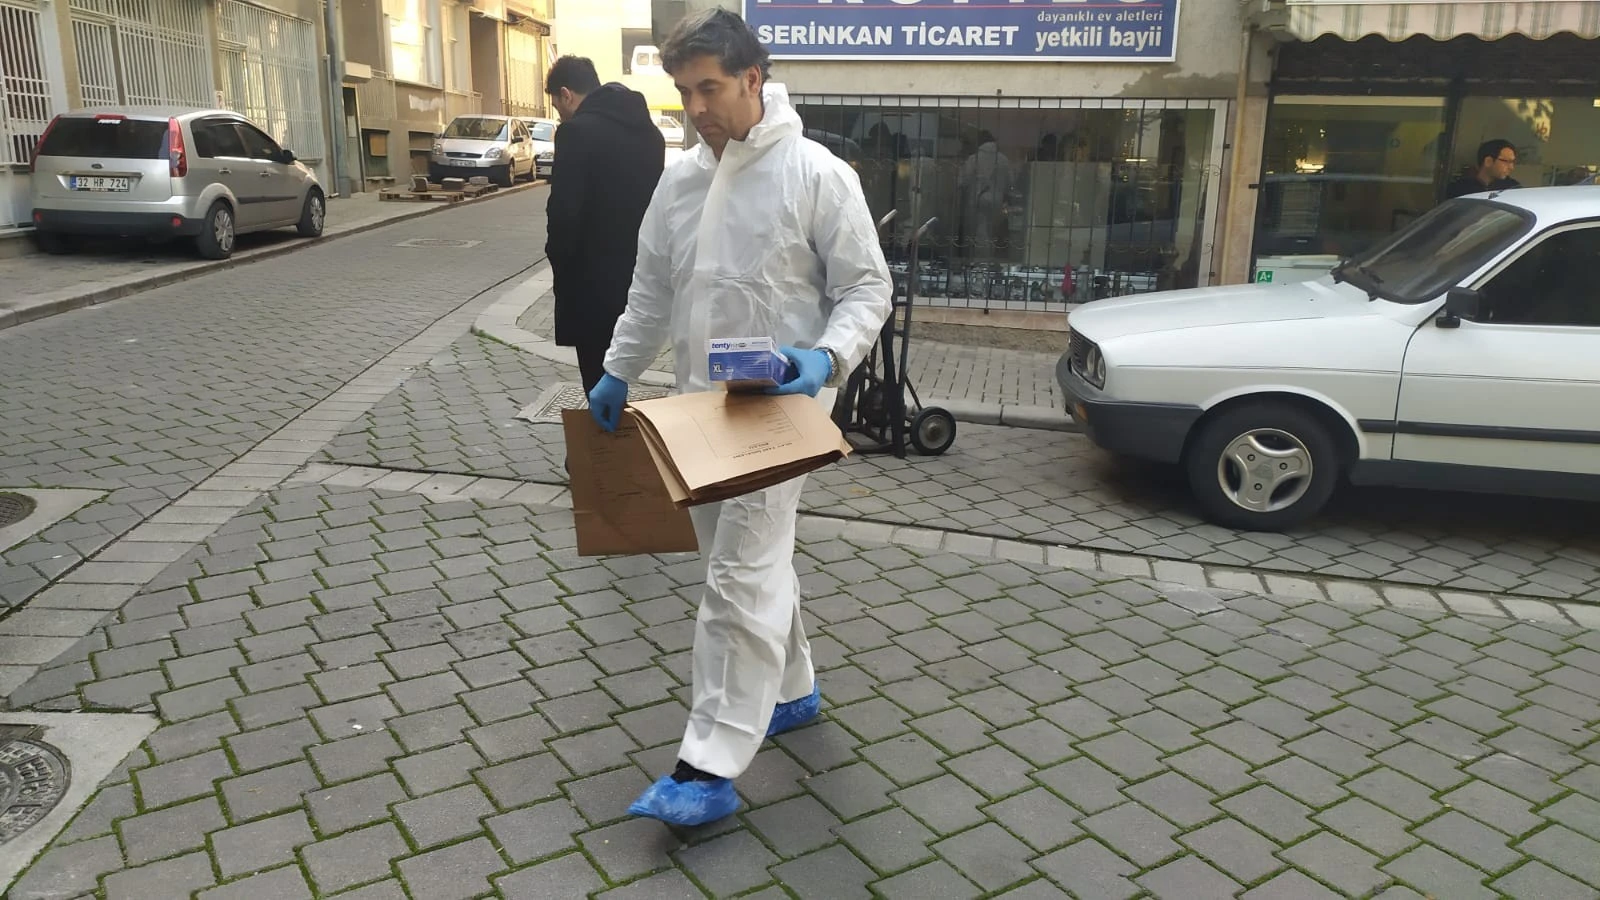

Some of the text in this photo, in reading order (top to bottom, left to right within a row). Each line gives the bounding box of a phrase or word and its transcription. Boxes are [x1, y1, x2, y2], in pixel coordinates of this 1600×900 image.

[1037, 11, 1094, 23] dayanıklı
[1116, 10, 1163, 21] aletleri
[757, 21, 1019, 46] SERİNKAN TİCARET
[1035, 26, 1162, 52] yetkili bayii
[78, 178, 89, 187] 32
[110, 178, 127, 188] 724
[713, 364, 724, 373] XL
